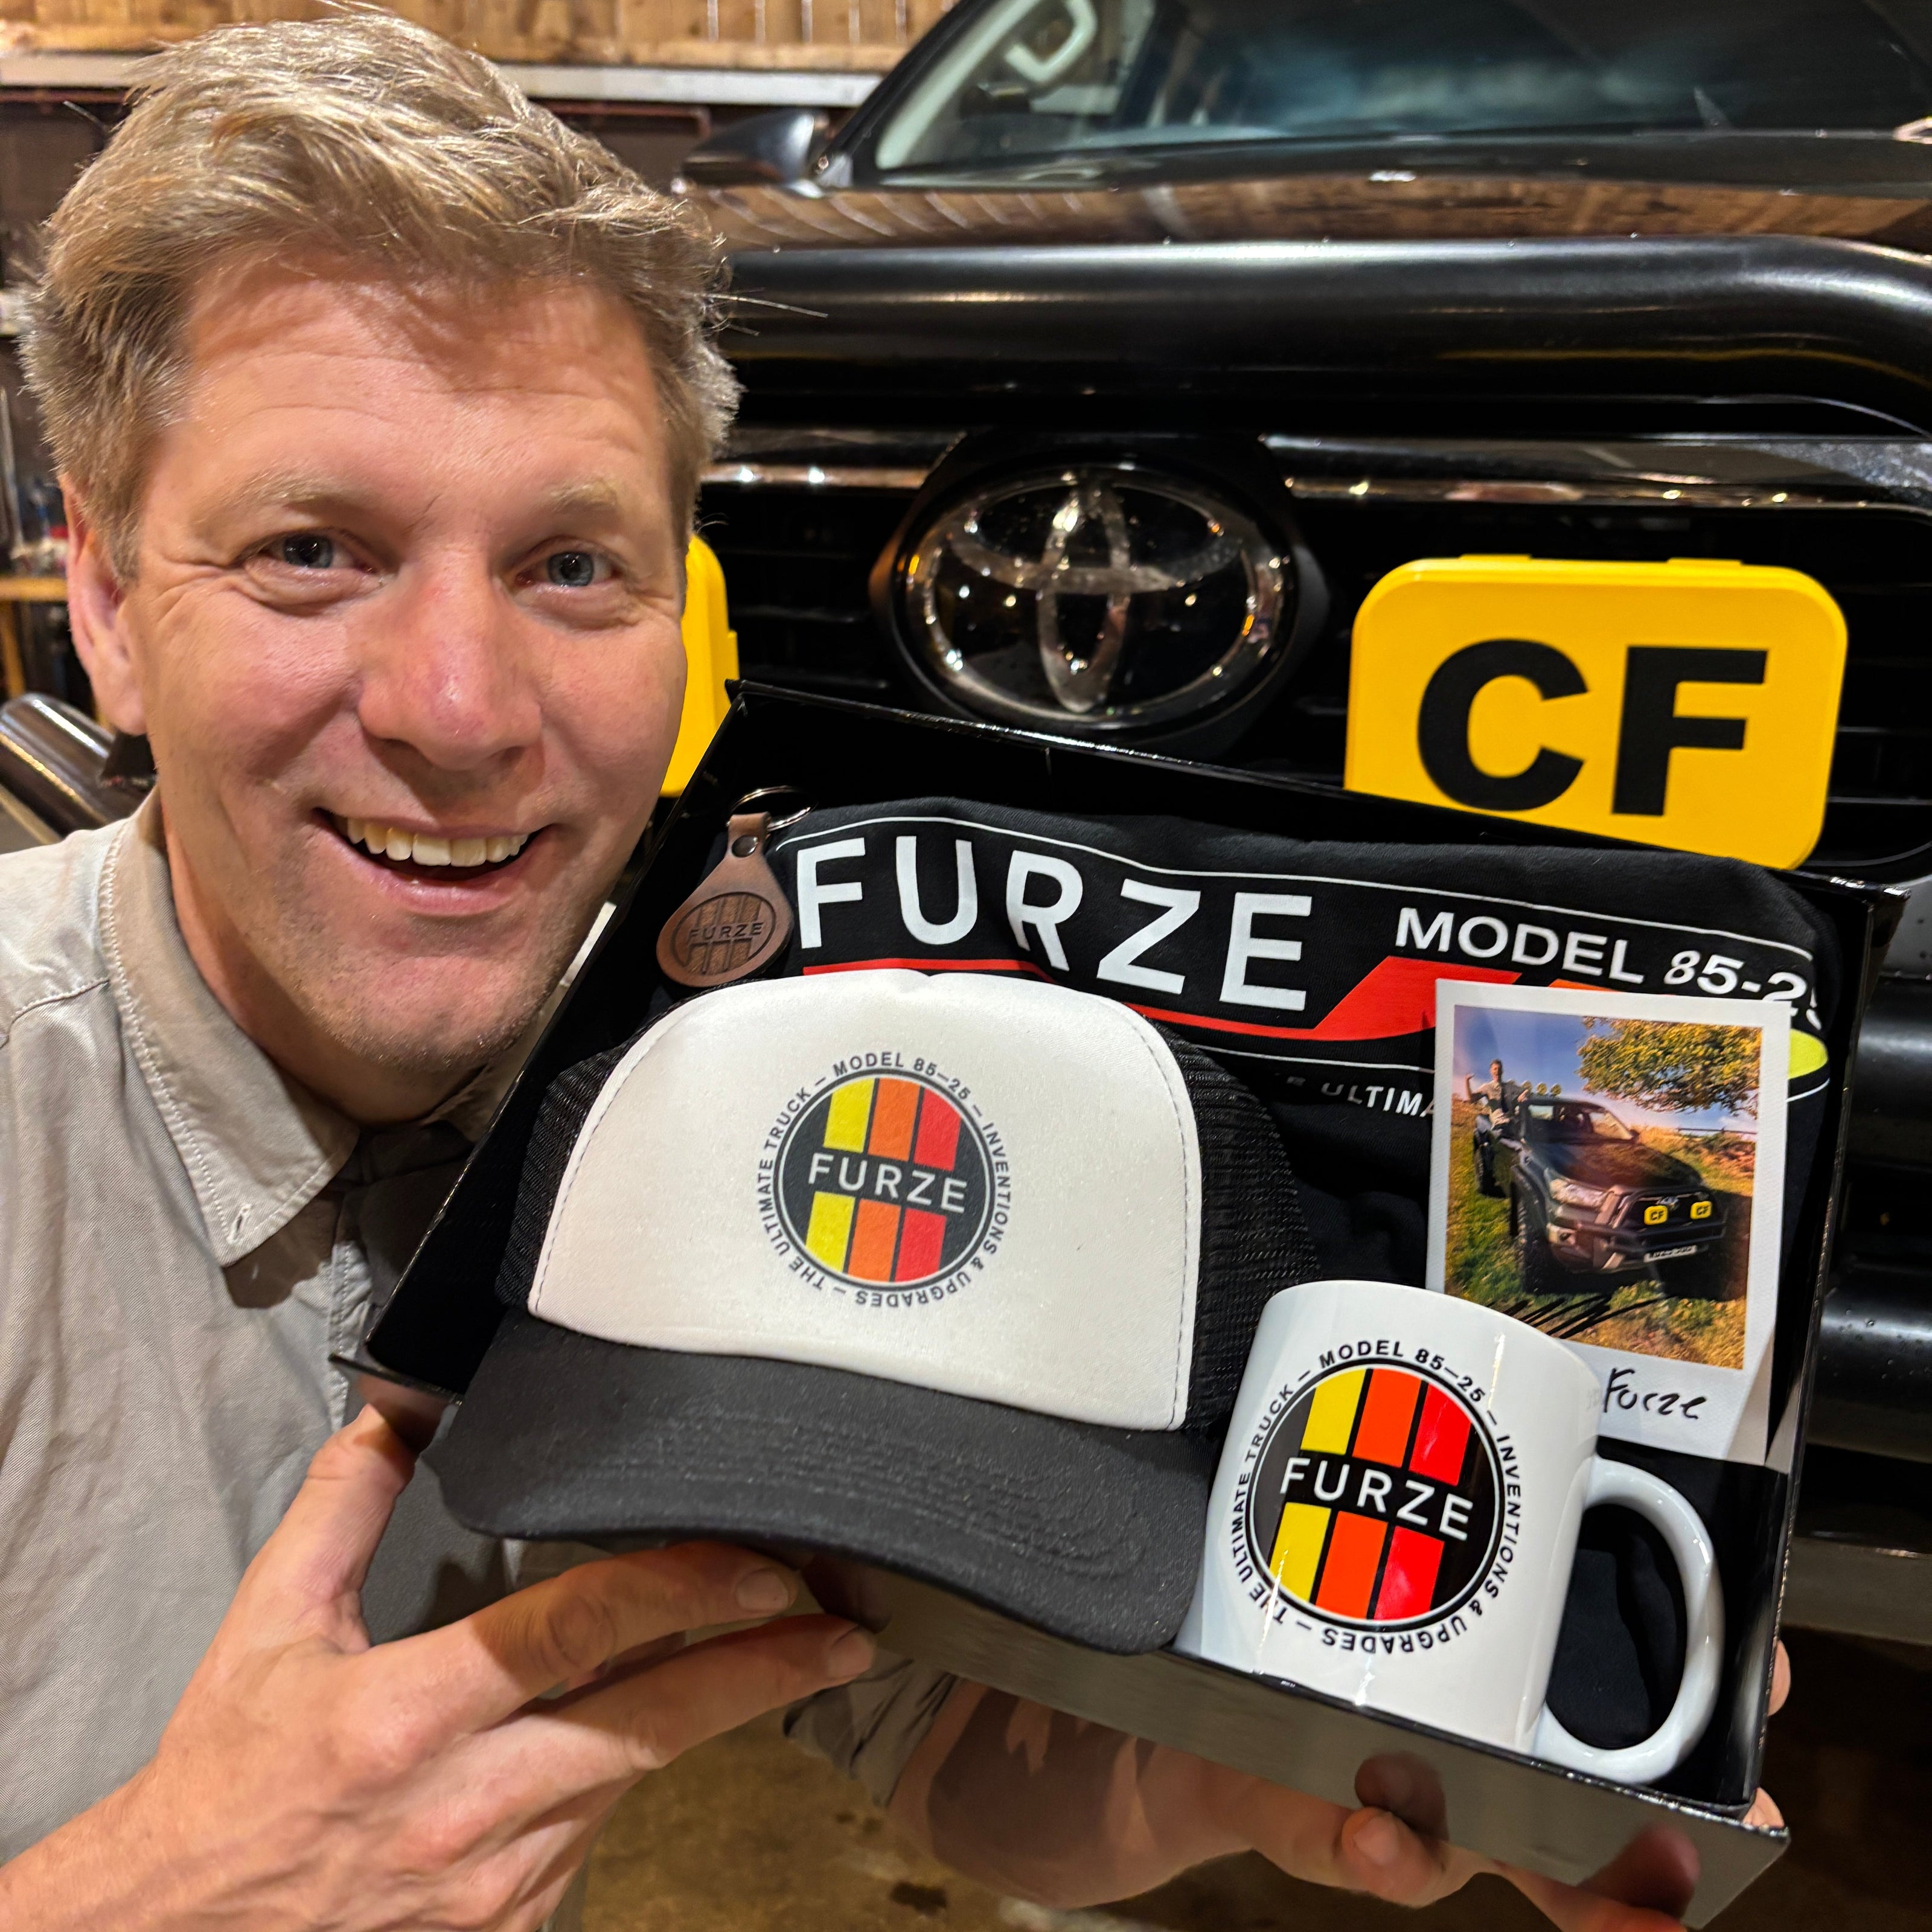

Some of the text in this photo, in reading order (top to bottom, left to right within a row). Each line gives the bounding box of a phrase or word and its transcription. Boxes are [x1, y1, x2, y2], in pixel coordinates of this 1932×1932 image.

[1418, 639, 1769, 816] CF
[686, 922, 763, 944] FURZE
[797, 836, 1312, 1011] FURZE
[1395, 907, 1645, 984] MODEL
[833, 1051, 904, 1076] MODEL
[763, 1087, 811, 1150] TRUCK
[758, 1159, 791, 1256] ULTIMATE
[808, 1153, 967, 1214] FURZE
[982, 1122, 1011, 1254] INVENTIONS
[788, 1255, 826, 1291] THE
[856, 1271, 971, 1308] UPGRADES
[970, 1256, 984, 1271] &
[1319, 1340, 1404, 1369] MODEL
[1244, 1384, 1294, 1462] TRUCK
[1231, 1472, 1254, 1584] ULTIMATE
[1280, 1457, 1473, 1541] FURZE
[1483, 1435, 1521, 1598] INVENTIONS
[1322, 1614, 1468, 1654] UPGRADES
[1468, 1599, 1483, 1616] &
